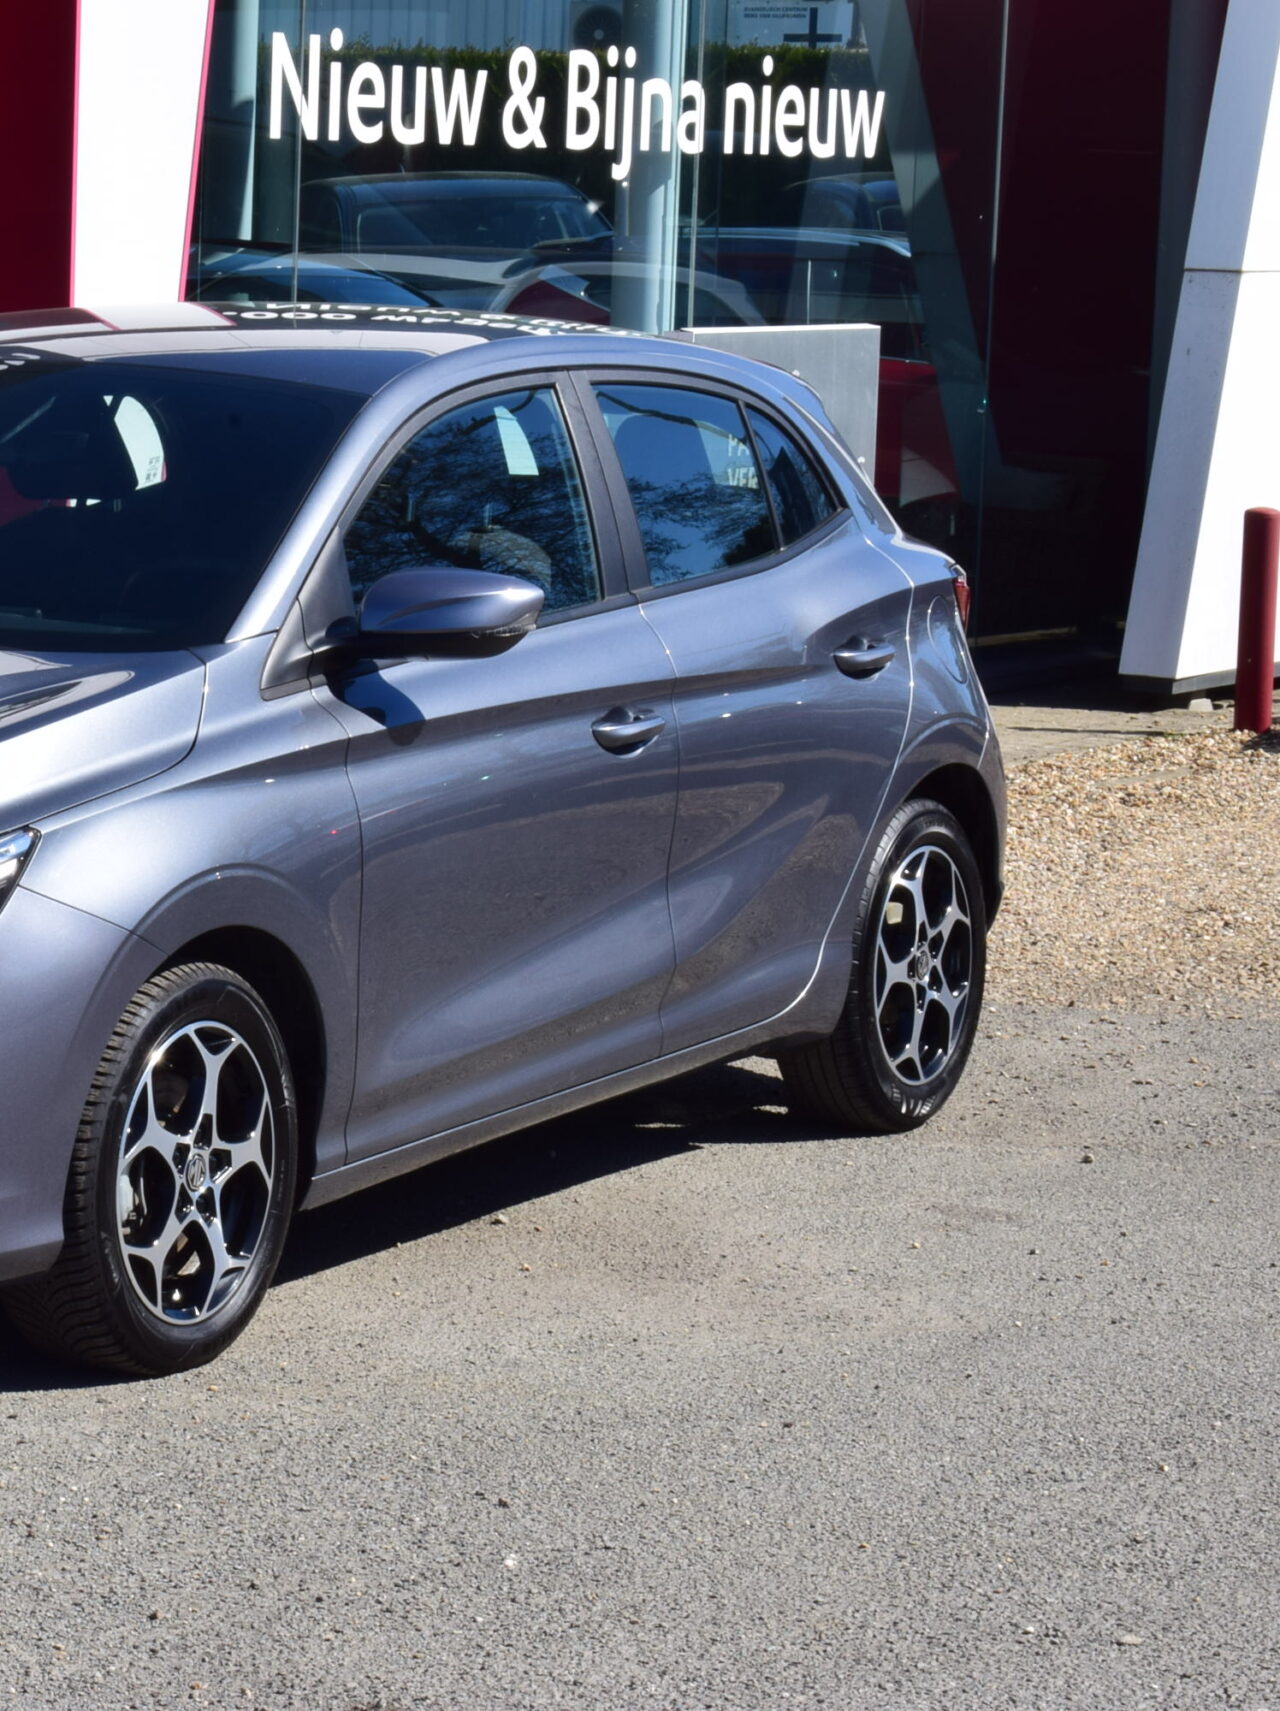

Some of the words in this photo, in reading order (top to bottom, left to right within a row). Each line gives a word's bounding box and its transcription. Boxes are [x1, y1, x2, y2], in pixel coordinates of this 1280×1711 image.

[270, 28, 488, 145] Nieuw
[502, 45, 547, 149] &
[565, 45, 705, 181] Bijna
[724, 56, 885, 158] nieuw
